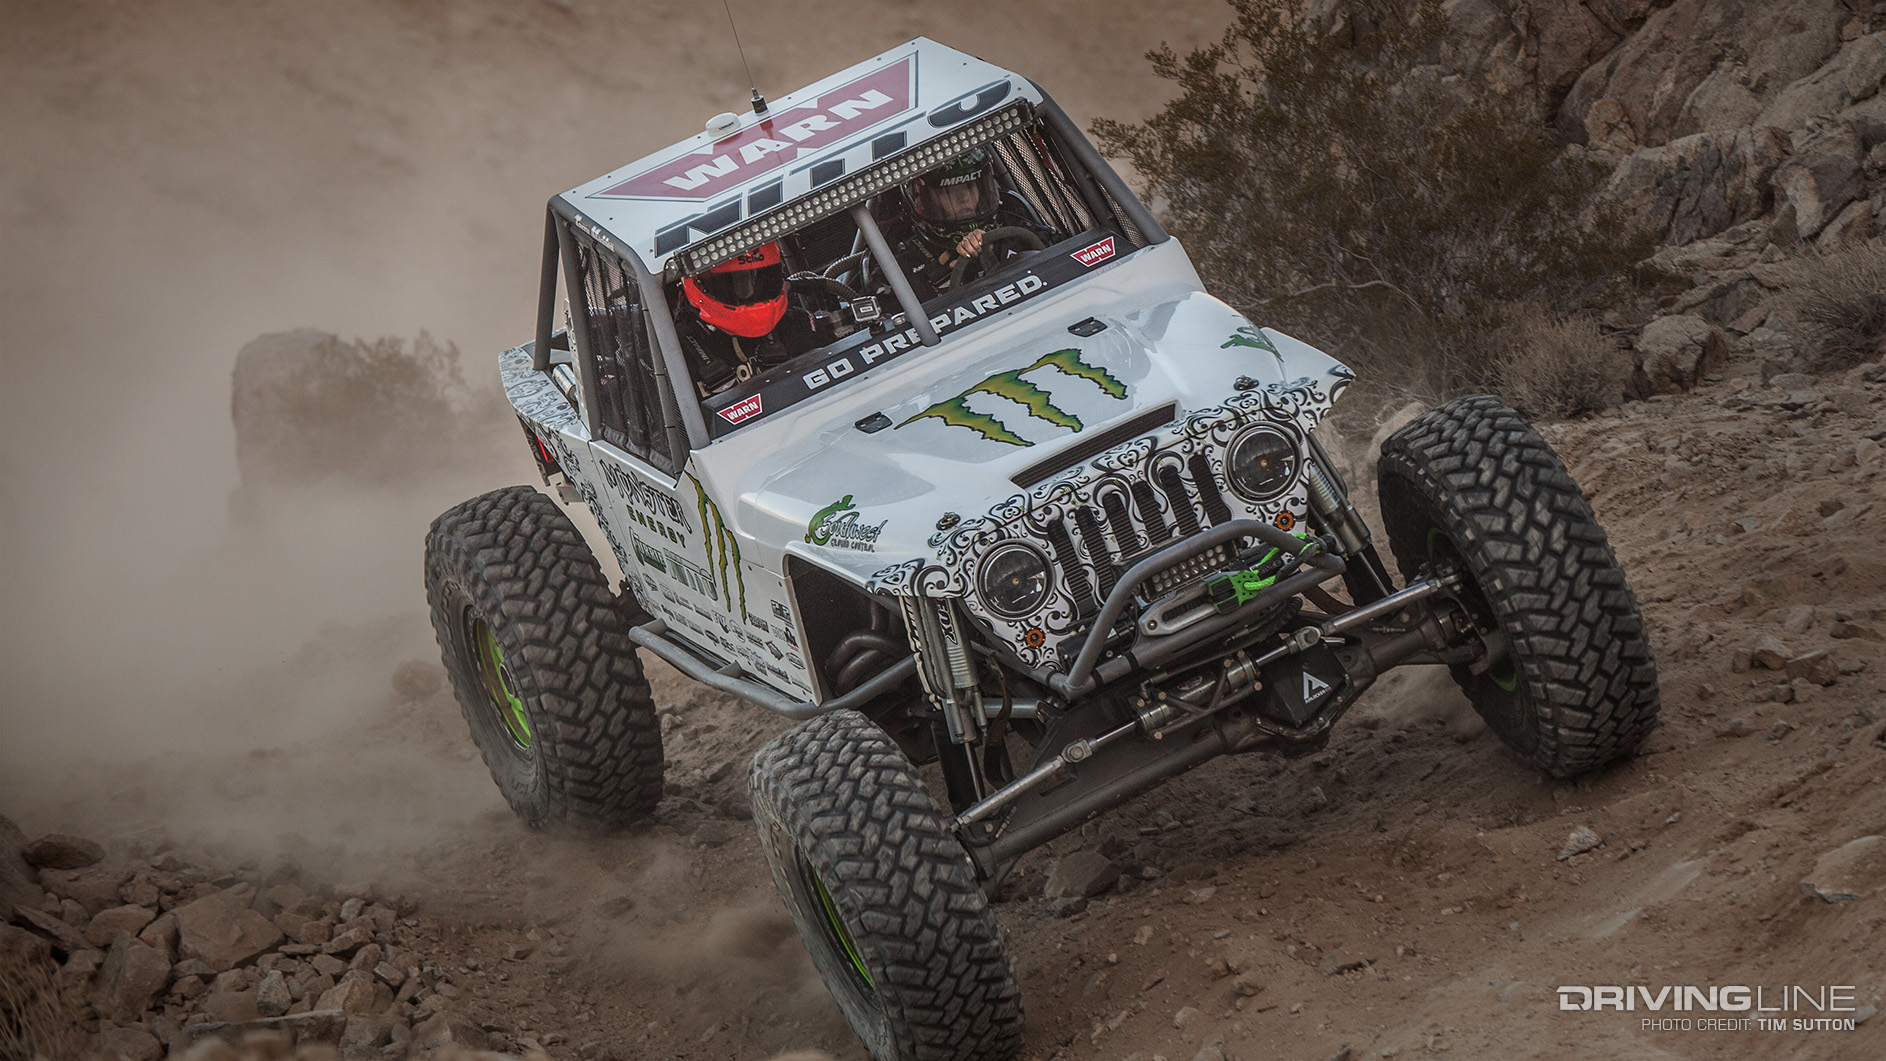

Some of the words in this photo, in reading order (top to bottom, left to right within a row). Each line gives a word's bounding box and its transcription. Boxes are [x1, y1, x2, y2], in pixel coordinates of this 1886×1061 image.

[662, 89, 894, 190] WARN
[940, 169, 982, 187] IMPACT
[1080, 244, 1112, 263] WARN
[802, 357, 855, 390] GO
[726, 401, 759, 421] WARN
[600, 459, 692, 534] MONSTER
[626, 504, 686, 549] ENERGY
[820, 512, 889, 543] Southwest
[937, 598, 958, 645] FOX
